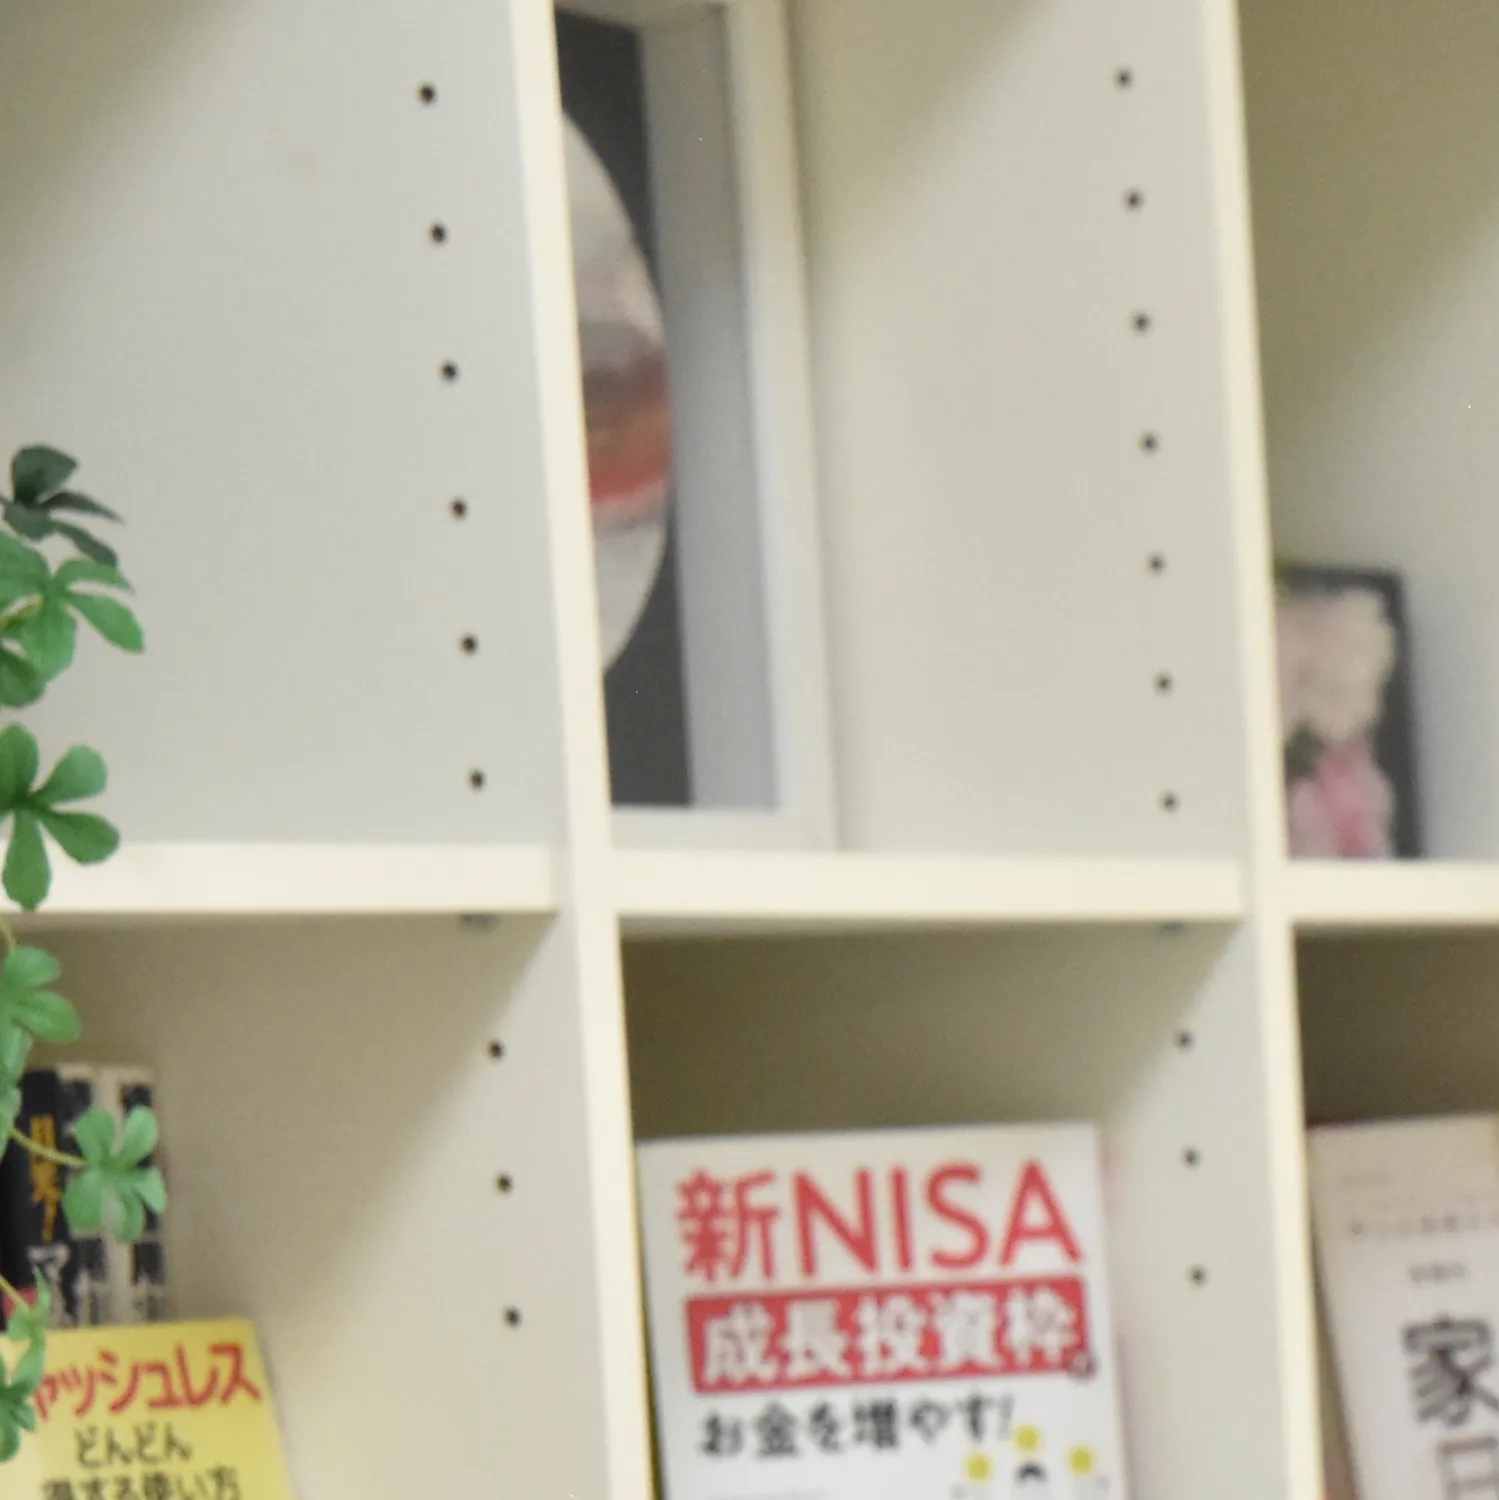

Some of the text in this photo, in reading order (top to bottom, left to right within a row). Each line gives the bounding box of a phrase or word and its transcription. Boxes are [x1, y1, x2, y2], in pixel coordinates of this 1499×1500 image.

[676, 1157, 1084, 1282] 新NISA
[33, 1340, 263, 1422] ャッシュレス
[74, 1421, 193, 1467] どんどん
[701, 1394, 1015, 1459] お金を増やす!
